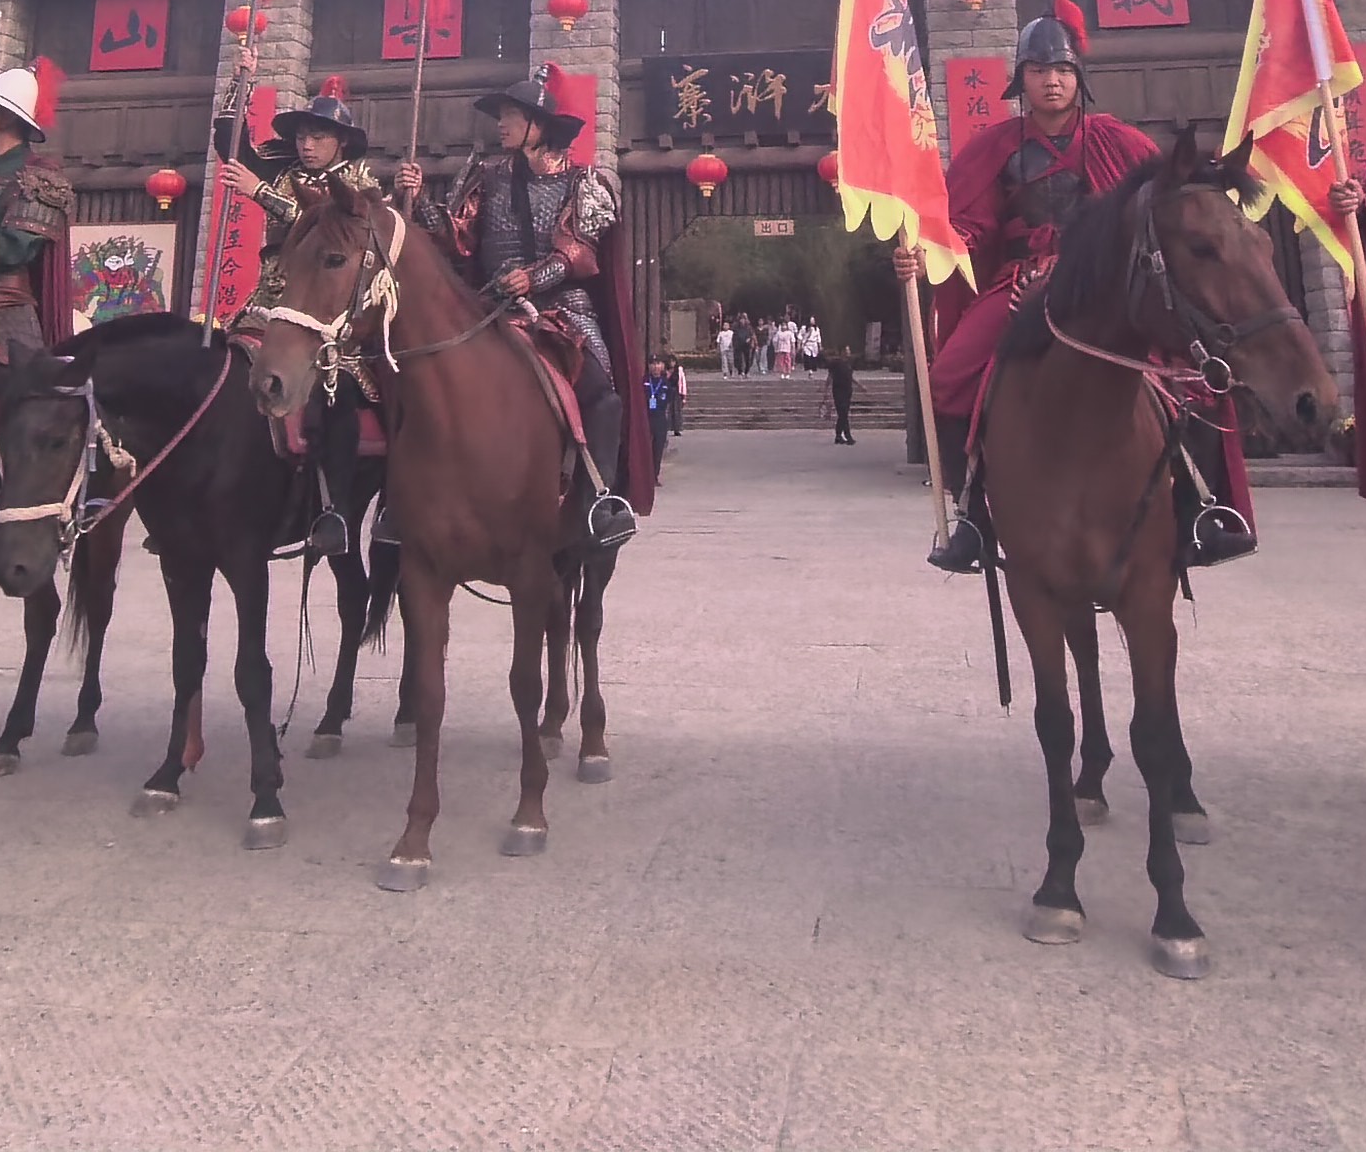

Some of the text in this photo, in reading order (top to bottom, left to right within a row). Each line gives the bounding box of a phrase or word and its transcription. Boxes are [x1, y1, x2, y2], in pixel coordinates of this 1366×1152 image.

[100, 9, 157, 54] 山
[964, 69, 989, 131] 水泊
[761, 223, 787, 233] 出口
